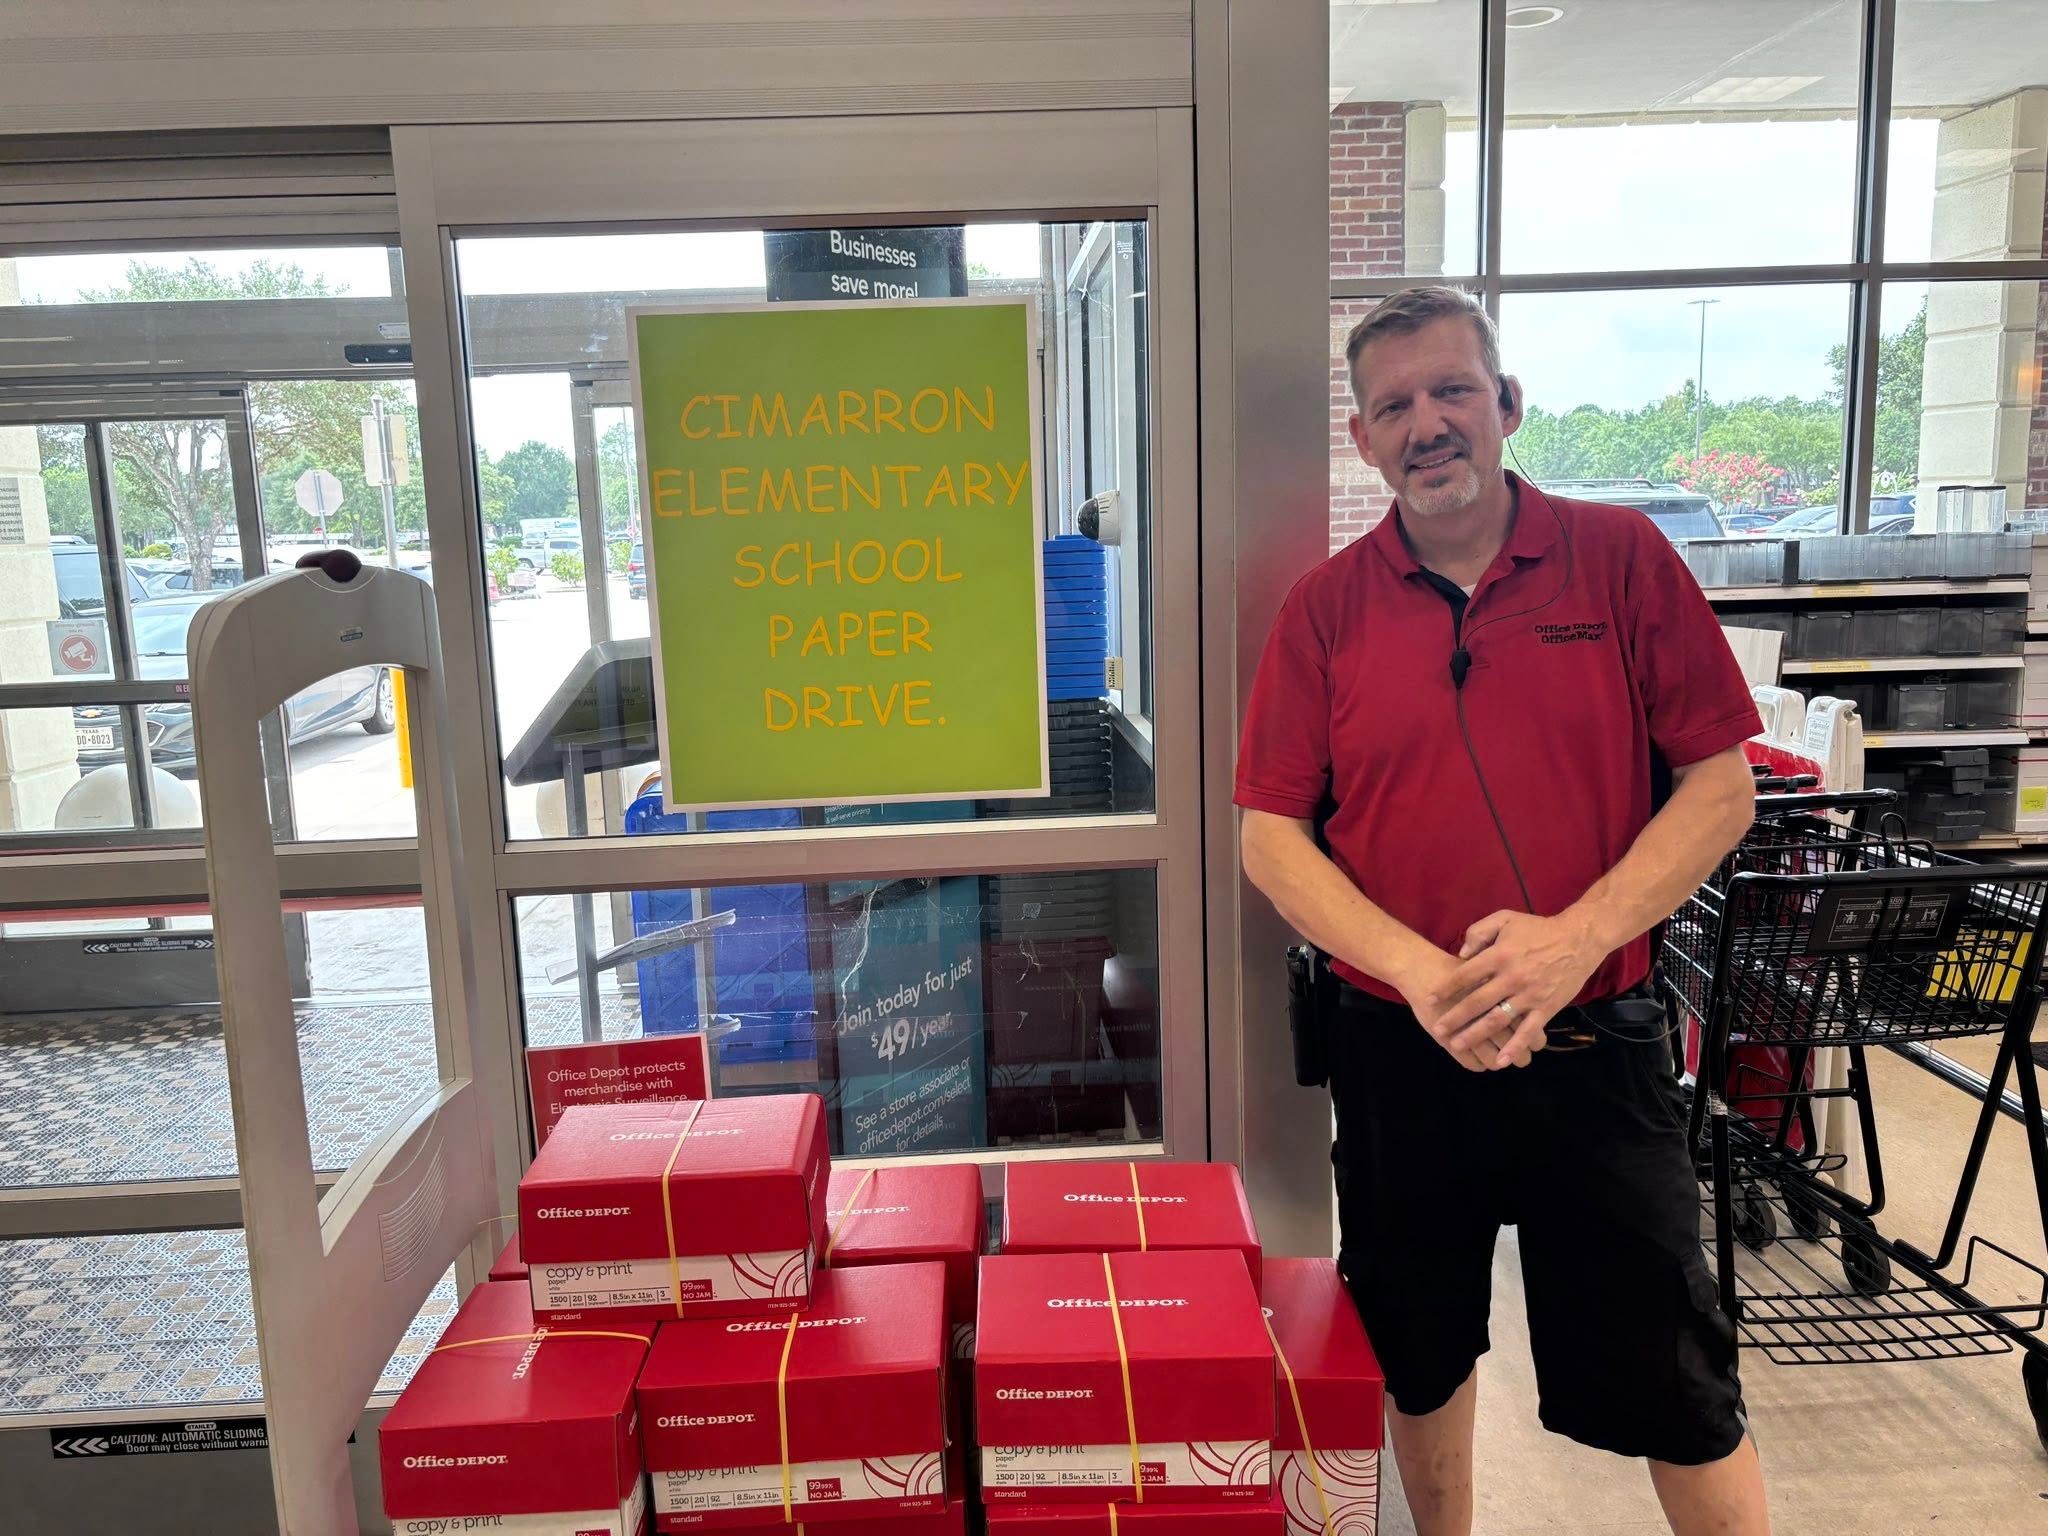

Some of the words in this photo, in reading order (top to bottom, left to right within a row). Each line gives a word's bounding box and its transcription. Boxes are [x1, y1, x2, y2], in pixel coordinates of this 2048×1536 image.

[830, 229, 917, 268] Businesses
[831, 273, 869, 296] save
[680, 386, 995, 440] CIMARRON
[654, 460, 1029, 517] ELEMENTARY
[733, 536, 964, 588] SCHOOL
[768, 610, 933, 658] PAPER
[1535, 624, 1571, 634] Office
[765, 680, 947, 732] DRIVE.
[839, 1006, 872, 1036] Join
[876, 983, 921, 1017] today
[924, 971, 946, 995] for
[950, 956, 972, 990] just
[548, 1069, 586, 1083] Office
[590, 1066, 630, 1081] Depot
[633, 1061, 686, 1078] protects
[564, 1080, 642, 1098] merchandise
[645, 1076, 673, 1090] with
[855, 1111, 877, 1134] See
[879, 1106, 887, 1120] a
[889, 1089, 917, 1114] store
[919, 1065, 960, 1098] associate
[961, 1056, 970, 1069] or
[859, 1075, 971, 1154] officedepot.com/select
[609, 1132, 675, 1141] Office
[895, 1134, 911, 1153] for
[912, 1114, 944, 1143] details
[1064, 1194, 1124, 1202] Office
[537, 1207, 583, 1219] Office
[546, 1266, 583, 1280] copy
[586, 1266, 594, 1276] &
[596, 1262, 633, 1279] print
[588, 1294, 598, 1302] 92
[1047, 1298, 1112, 1308] Office
[726, 1322, 792, 1332] Office
[996, 1388, 1044, 1400] Office
[657, 1415, 705, 1428] Office
[110, 1434, 158, 1445] CAUTION:
[162, 1430, 221, 1443] AUTOMATIC
[224, 1428, 264, 1440] SLIDING
[126, 1444, 148, 1453] Door
[151, 1444, 170, 1453] may
[174, 1441, 200, 1450] close
[202, 1440, 238, 1449] without
[240, 1438, 268, 1448] warni
[994, 1446, 1033, 1458] copy
[1048, 1445, 1085, 1457] print
[404, 1455, 454, 1468] Office
[666, 1468, 705, 1480] copy
[994, 1490, 1026, 1498] standard
[407, 1520, 448, 1534] copy
[451, 1518, 460, 1529] &
[464, 1514, 503, 1531] print
